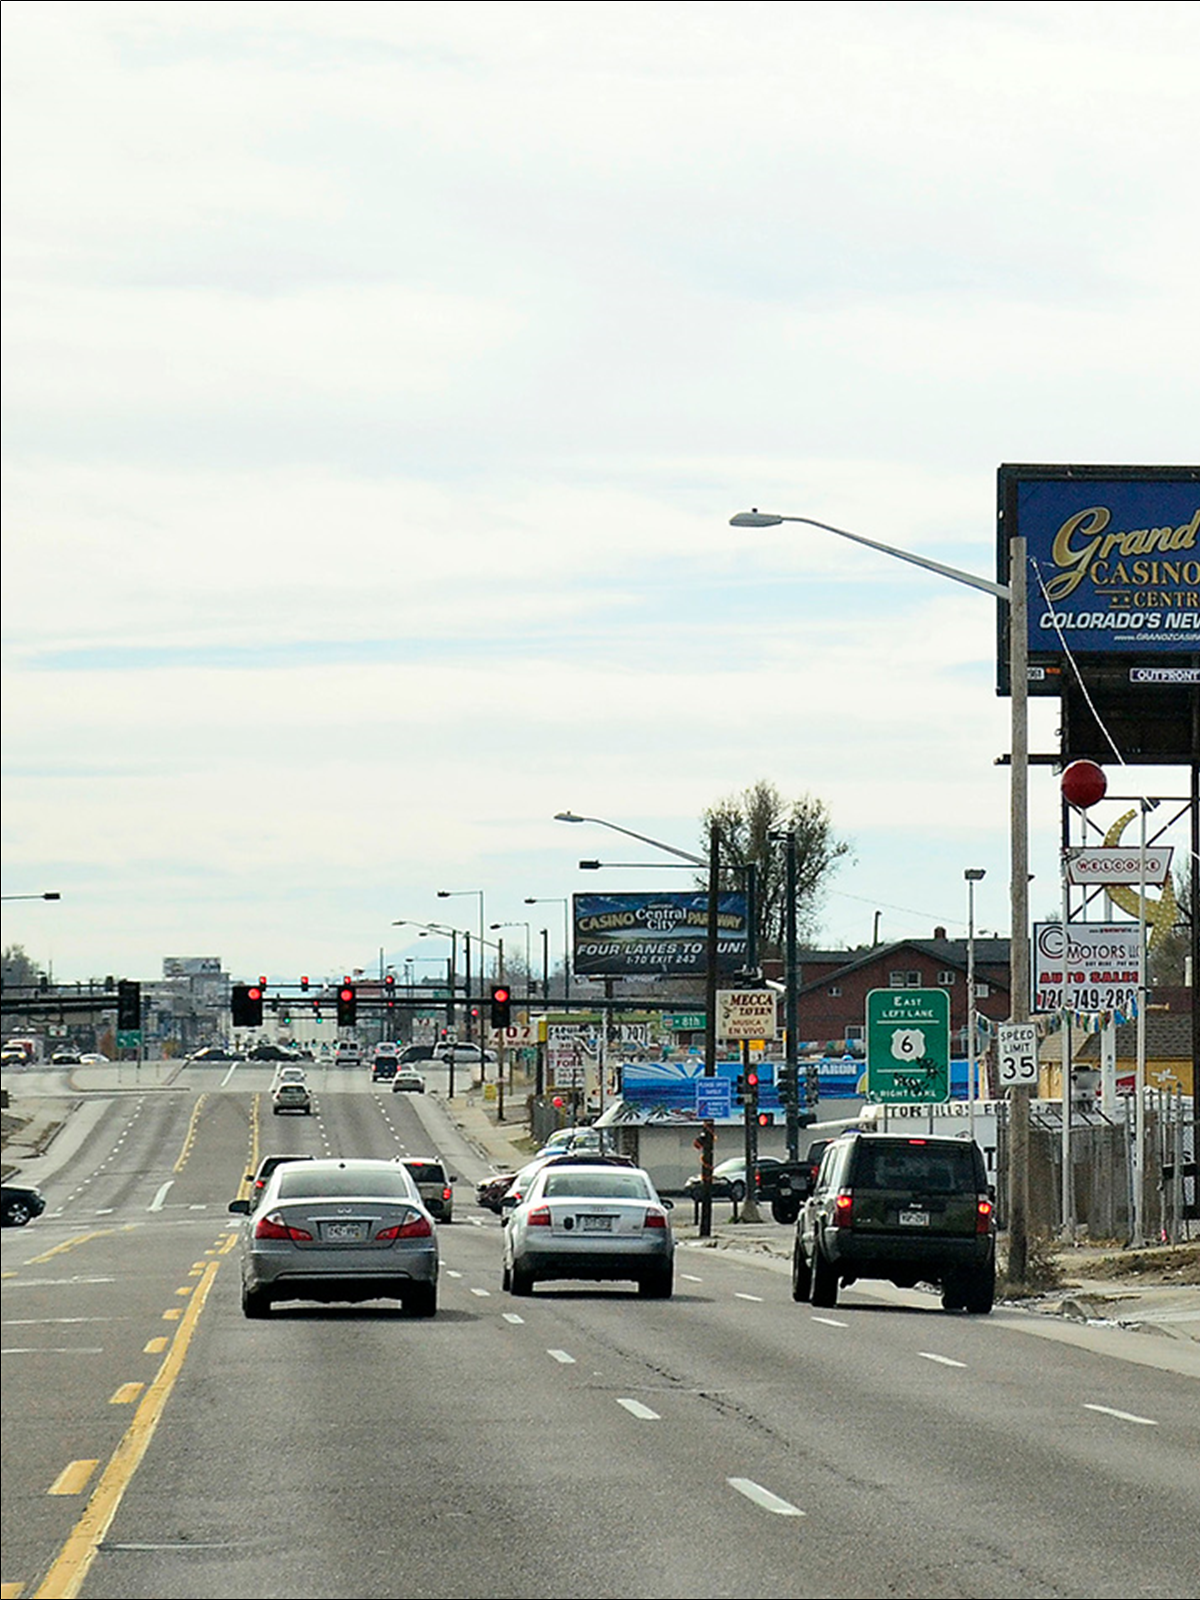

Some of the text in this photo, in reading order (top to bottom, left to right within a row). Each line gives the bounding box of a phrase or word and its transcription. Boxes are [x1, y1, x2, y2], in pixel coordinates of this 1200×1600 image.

[1039, 611, 1162, 630] COLORADO'S
[1136, 670, 1200, 682] OUTFRONT
[1078, 860, 1160, 872] WELCOE
[578, 907, 743, 931] CASINO Central PARWAY
[647, 918, 677, 932] City
[577, 941, 748, 955] FOUR LANES TO UN!
[1067, 944, 1127, 959] MOTORS
[650, 956, 673, 964] EXIT
[1039, 971, 1139, 984] AUTO SALES
[729, 993, 774, 1006] MECCA
[893, 996, 923, 1007] EAST
[882, 1009, 935, 1018] LEFT LANE
[728, 1027, 766, 1035] EN VIVO
[1001, 1029, 1035, 1042] SPEED
[901, 1035, 914, 1054] 6
[1003, 1043, 1031, 1054] LIMIT
[1003, 1055, 1035, 1079] 35
